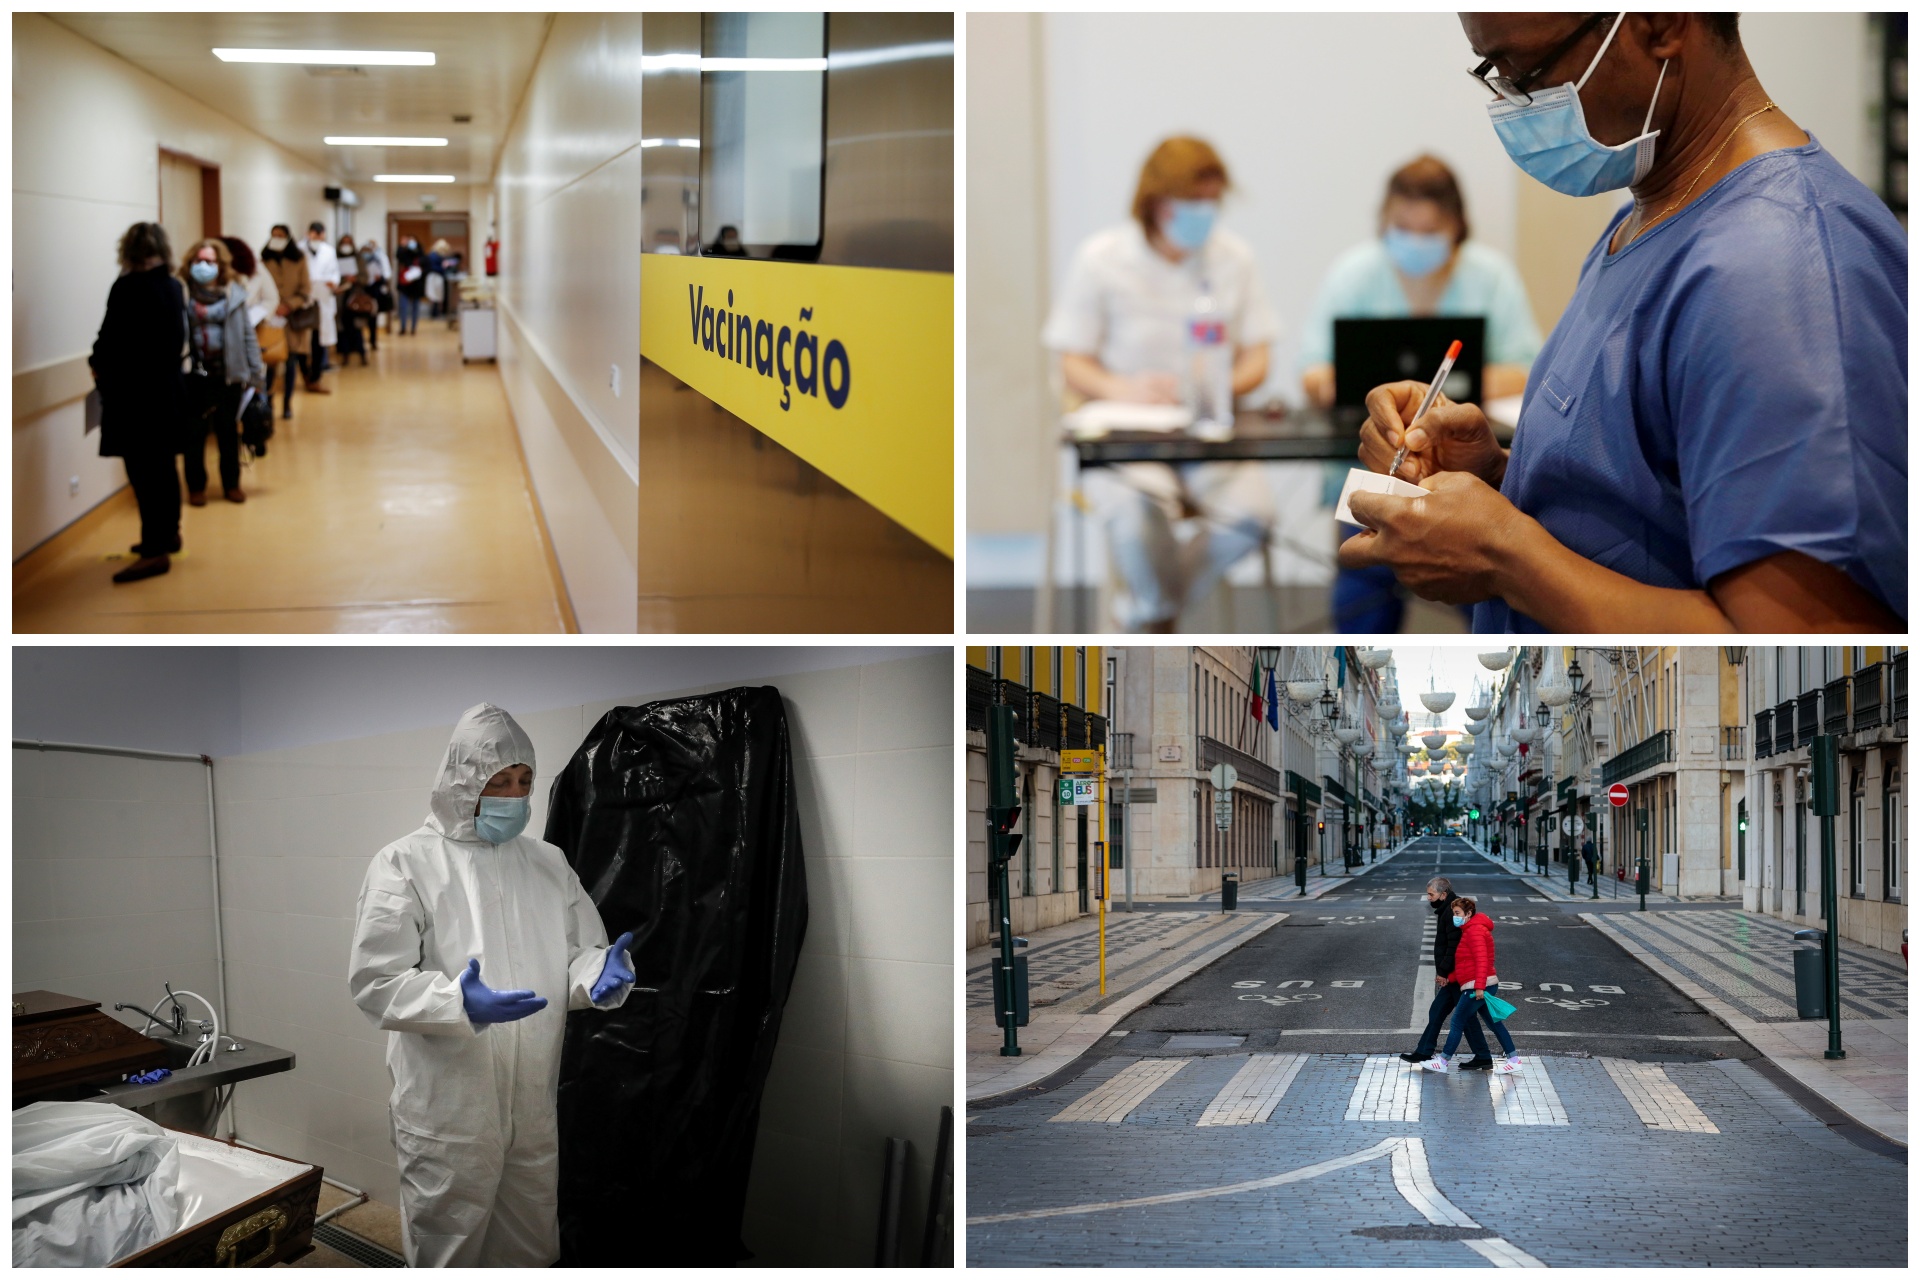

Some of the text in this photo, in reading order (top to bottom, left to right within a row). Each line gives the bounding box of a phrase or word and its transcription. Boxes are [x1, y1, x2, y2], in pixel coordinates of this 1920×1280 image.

[689, 283, 851, 412] Vacinação
[1075, 785, 1092, 795] BUS
[1231, 980, 1365, 989] BUS
[1498, 981, 1626, 995] BUS
